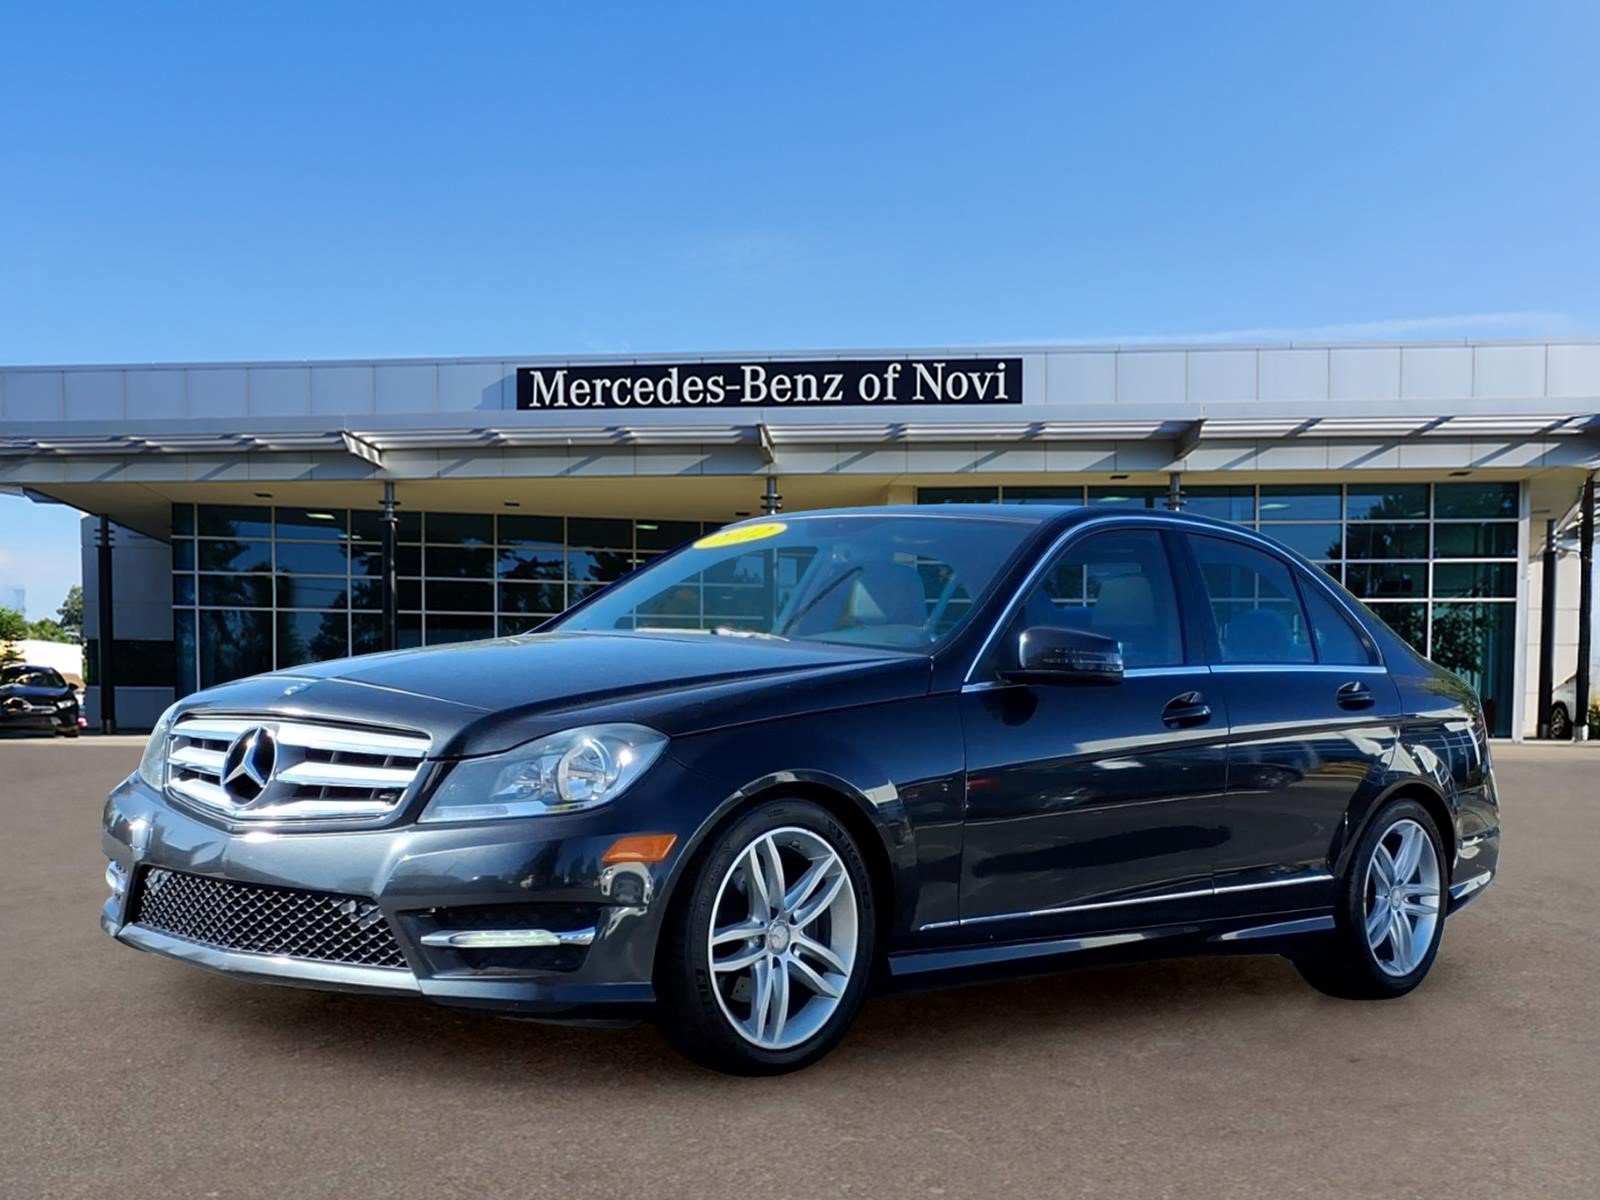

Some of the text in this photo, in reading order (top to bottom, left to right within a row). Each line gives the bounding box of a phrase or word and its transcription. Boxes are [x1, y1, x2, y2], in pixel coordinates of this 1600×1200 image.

[528, 362, 1009, 407] Mercedes-Benz of Novi
